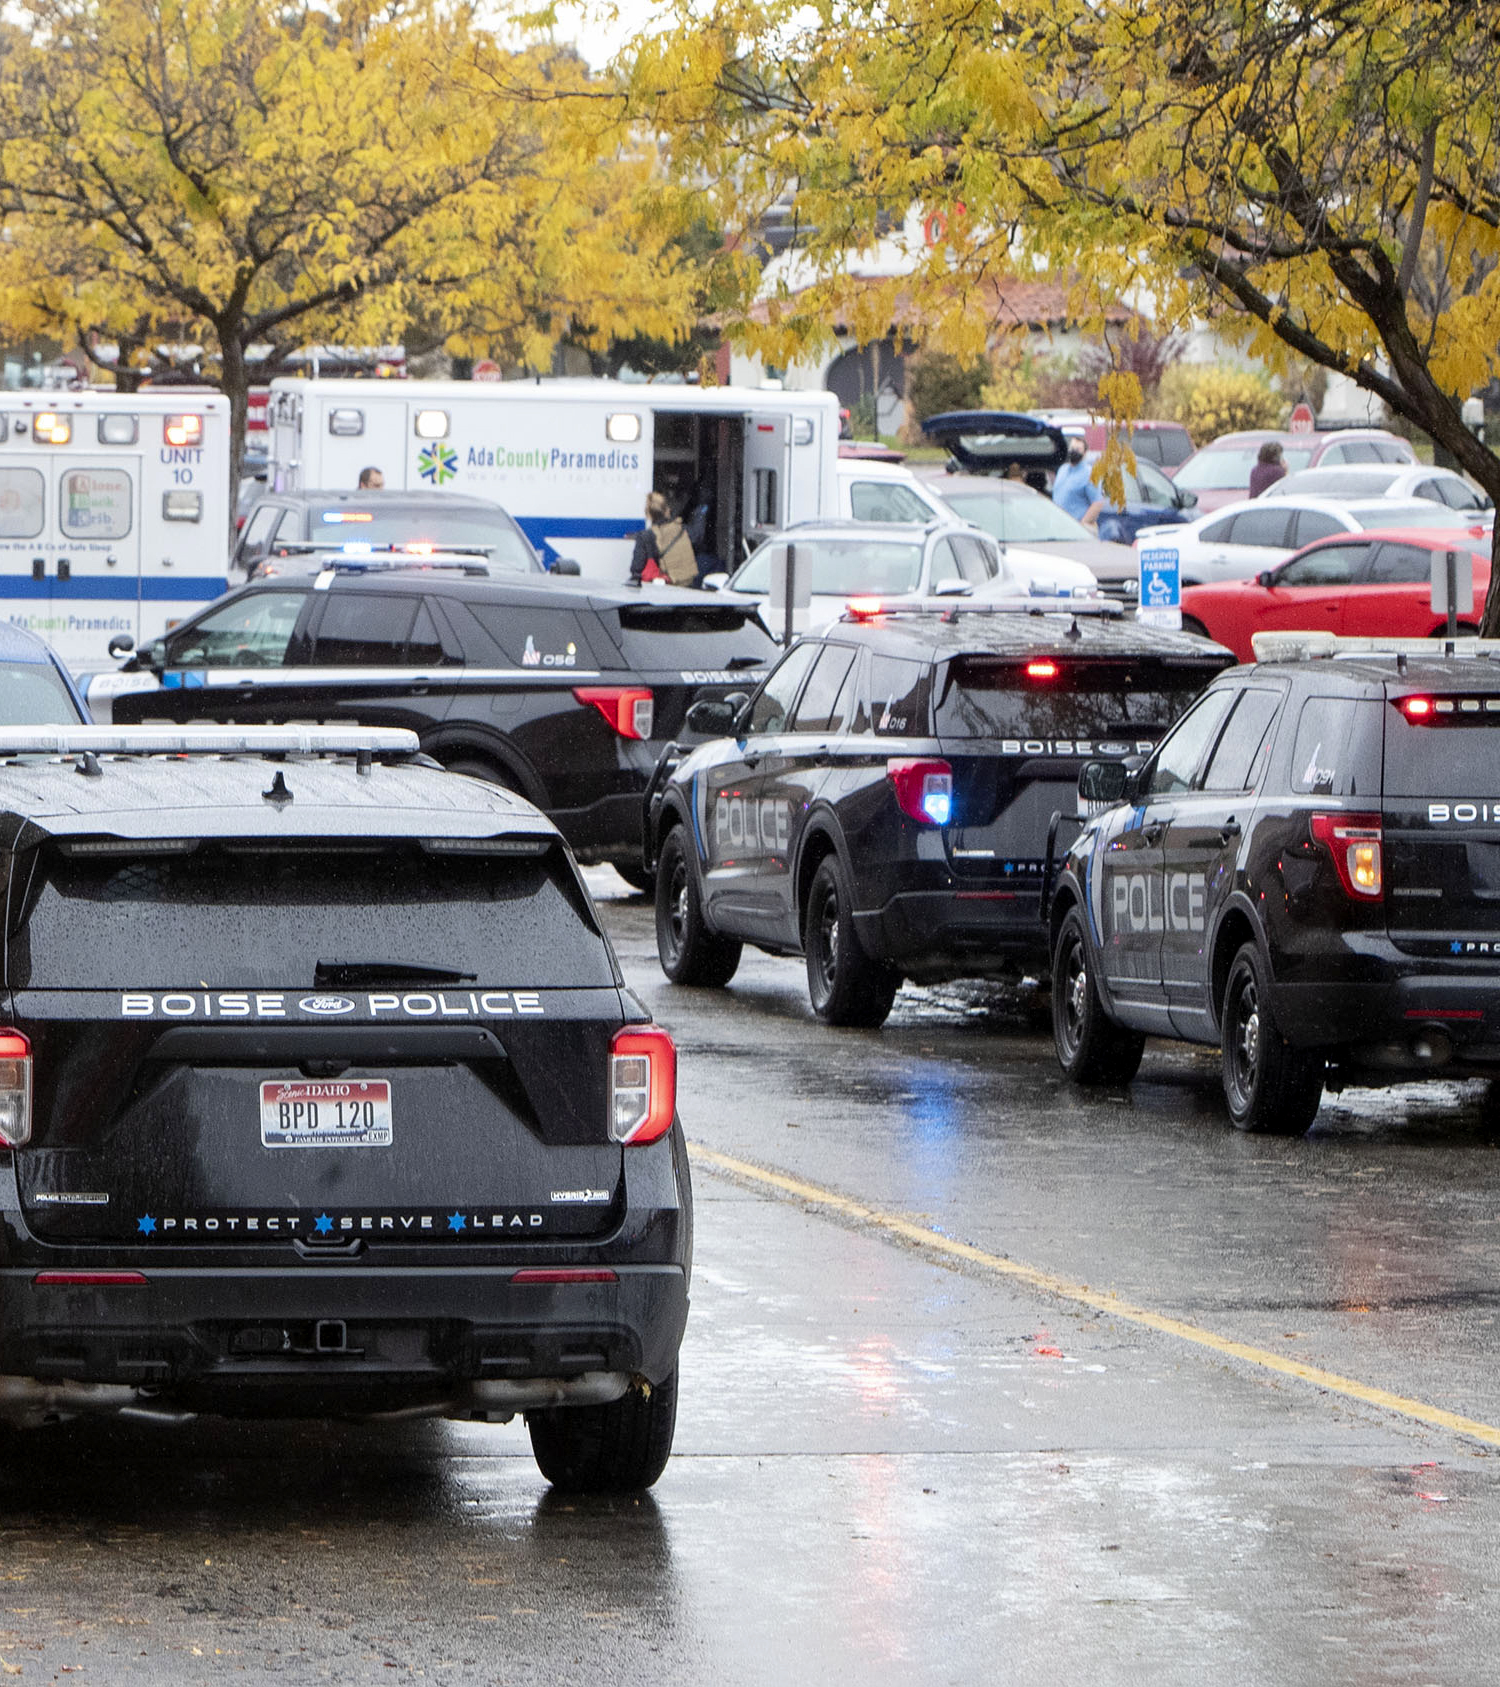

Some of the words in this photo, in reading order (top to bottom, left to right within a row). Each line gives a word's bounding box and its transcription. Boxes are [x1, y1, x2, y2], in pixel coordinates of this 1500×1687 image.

[160, 450, 204, 464] UNIT
[467, 446, 639, 471] AdaCountyParamedics
[173, 469, 193, 484] 10
[543, 654, 576, 666] 056
[681, 671, 734, 684] BOISE
[1002, 740, 1093, 754] BOISE
[715, 797, 789, 850] POLICE
[1113, 872, 1205, 931] POLICE
[121, 994, 286, 1016] BOISE
[368, 992, 544, 1016] POLICE
[306, 1085, 350, 1097] IDAHO
[279, 1101, 319, 1130] BPD
[335, 1101, 374, 1129] 120
[368, 1131, 388, 1140] EXMP
[163, 1217, 300, 1230] PROTECT
[340, 1216, 433, 1230] SERVE
[473, 1214, 543, 1228] LEAD
